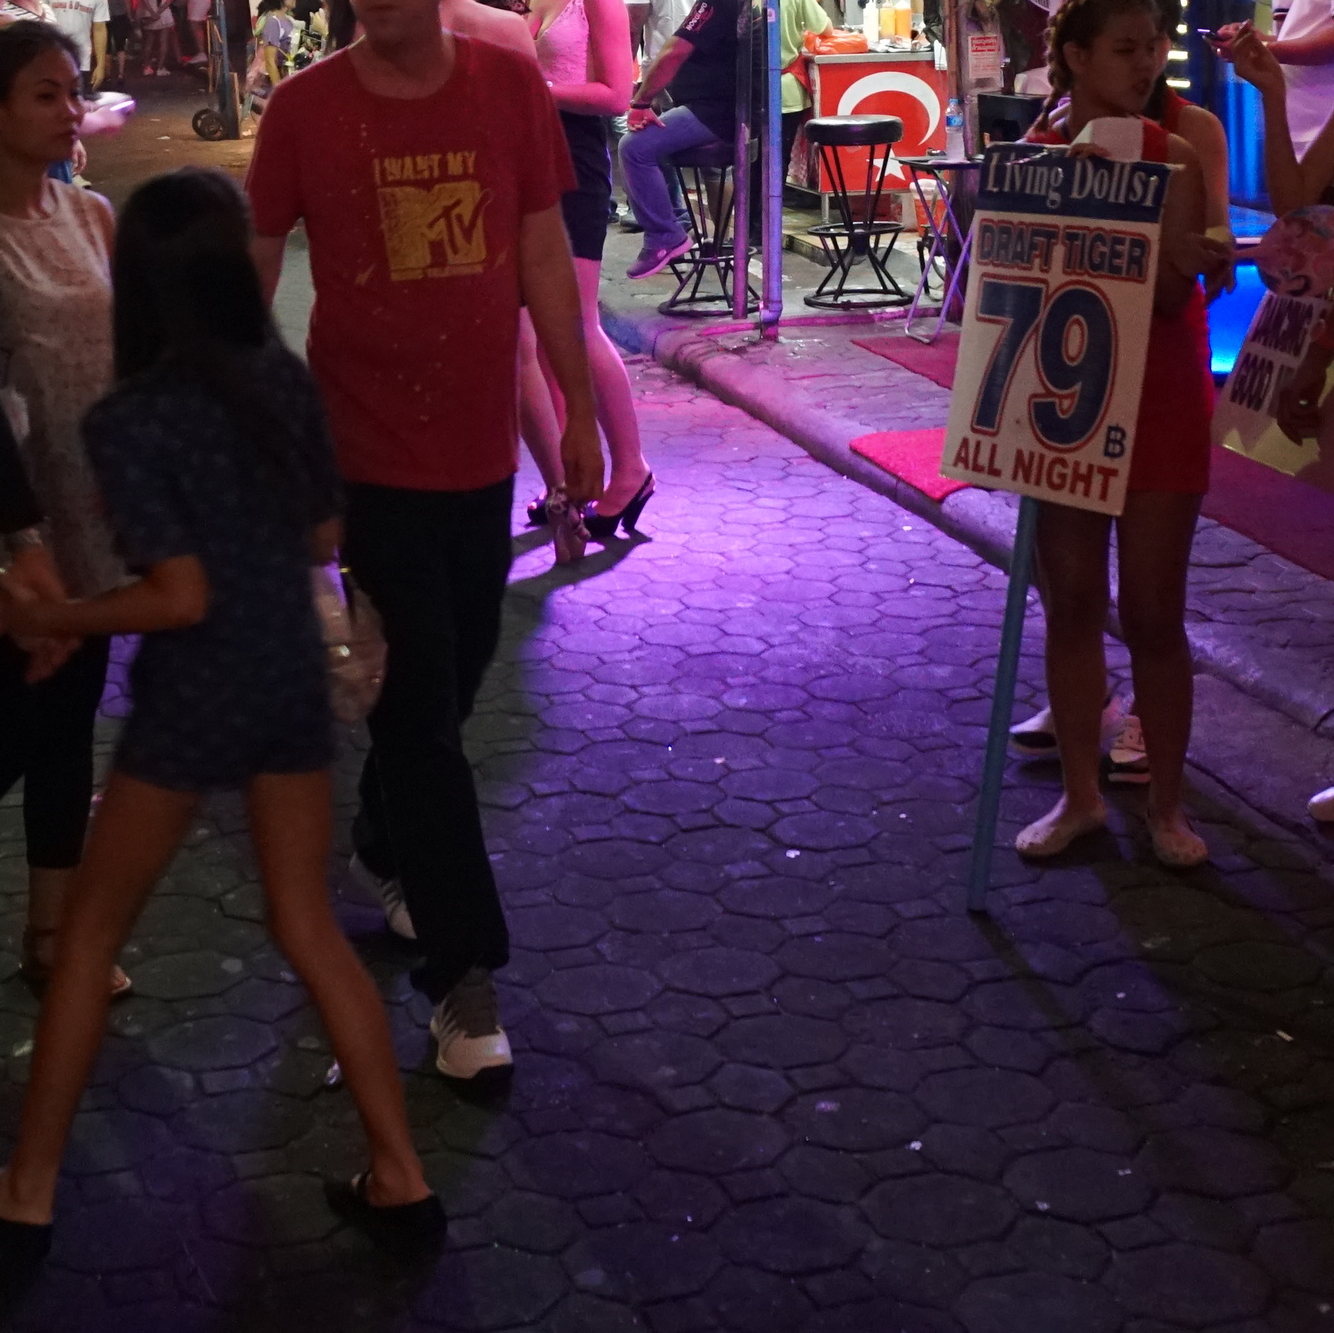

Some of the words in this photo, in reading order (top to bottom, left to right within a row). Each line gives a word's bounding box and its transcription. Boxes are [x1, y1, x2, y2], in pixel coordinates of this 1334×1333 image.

[446, 150, 477, 177] MY
[985, 147, 1064, 209] Living
[377, 179, 495, 271] MTV
[976, 218, 1061, 273] DRAFT
[1062, 225, 1152, 283] TIGER
[971, 273, 1119, 454] 79
[952, 436, 1003, 478] ALL
[1012, 446, 1121, 504] NIGHT
